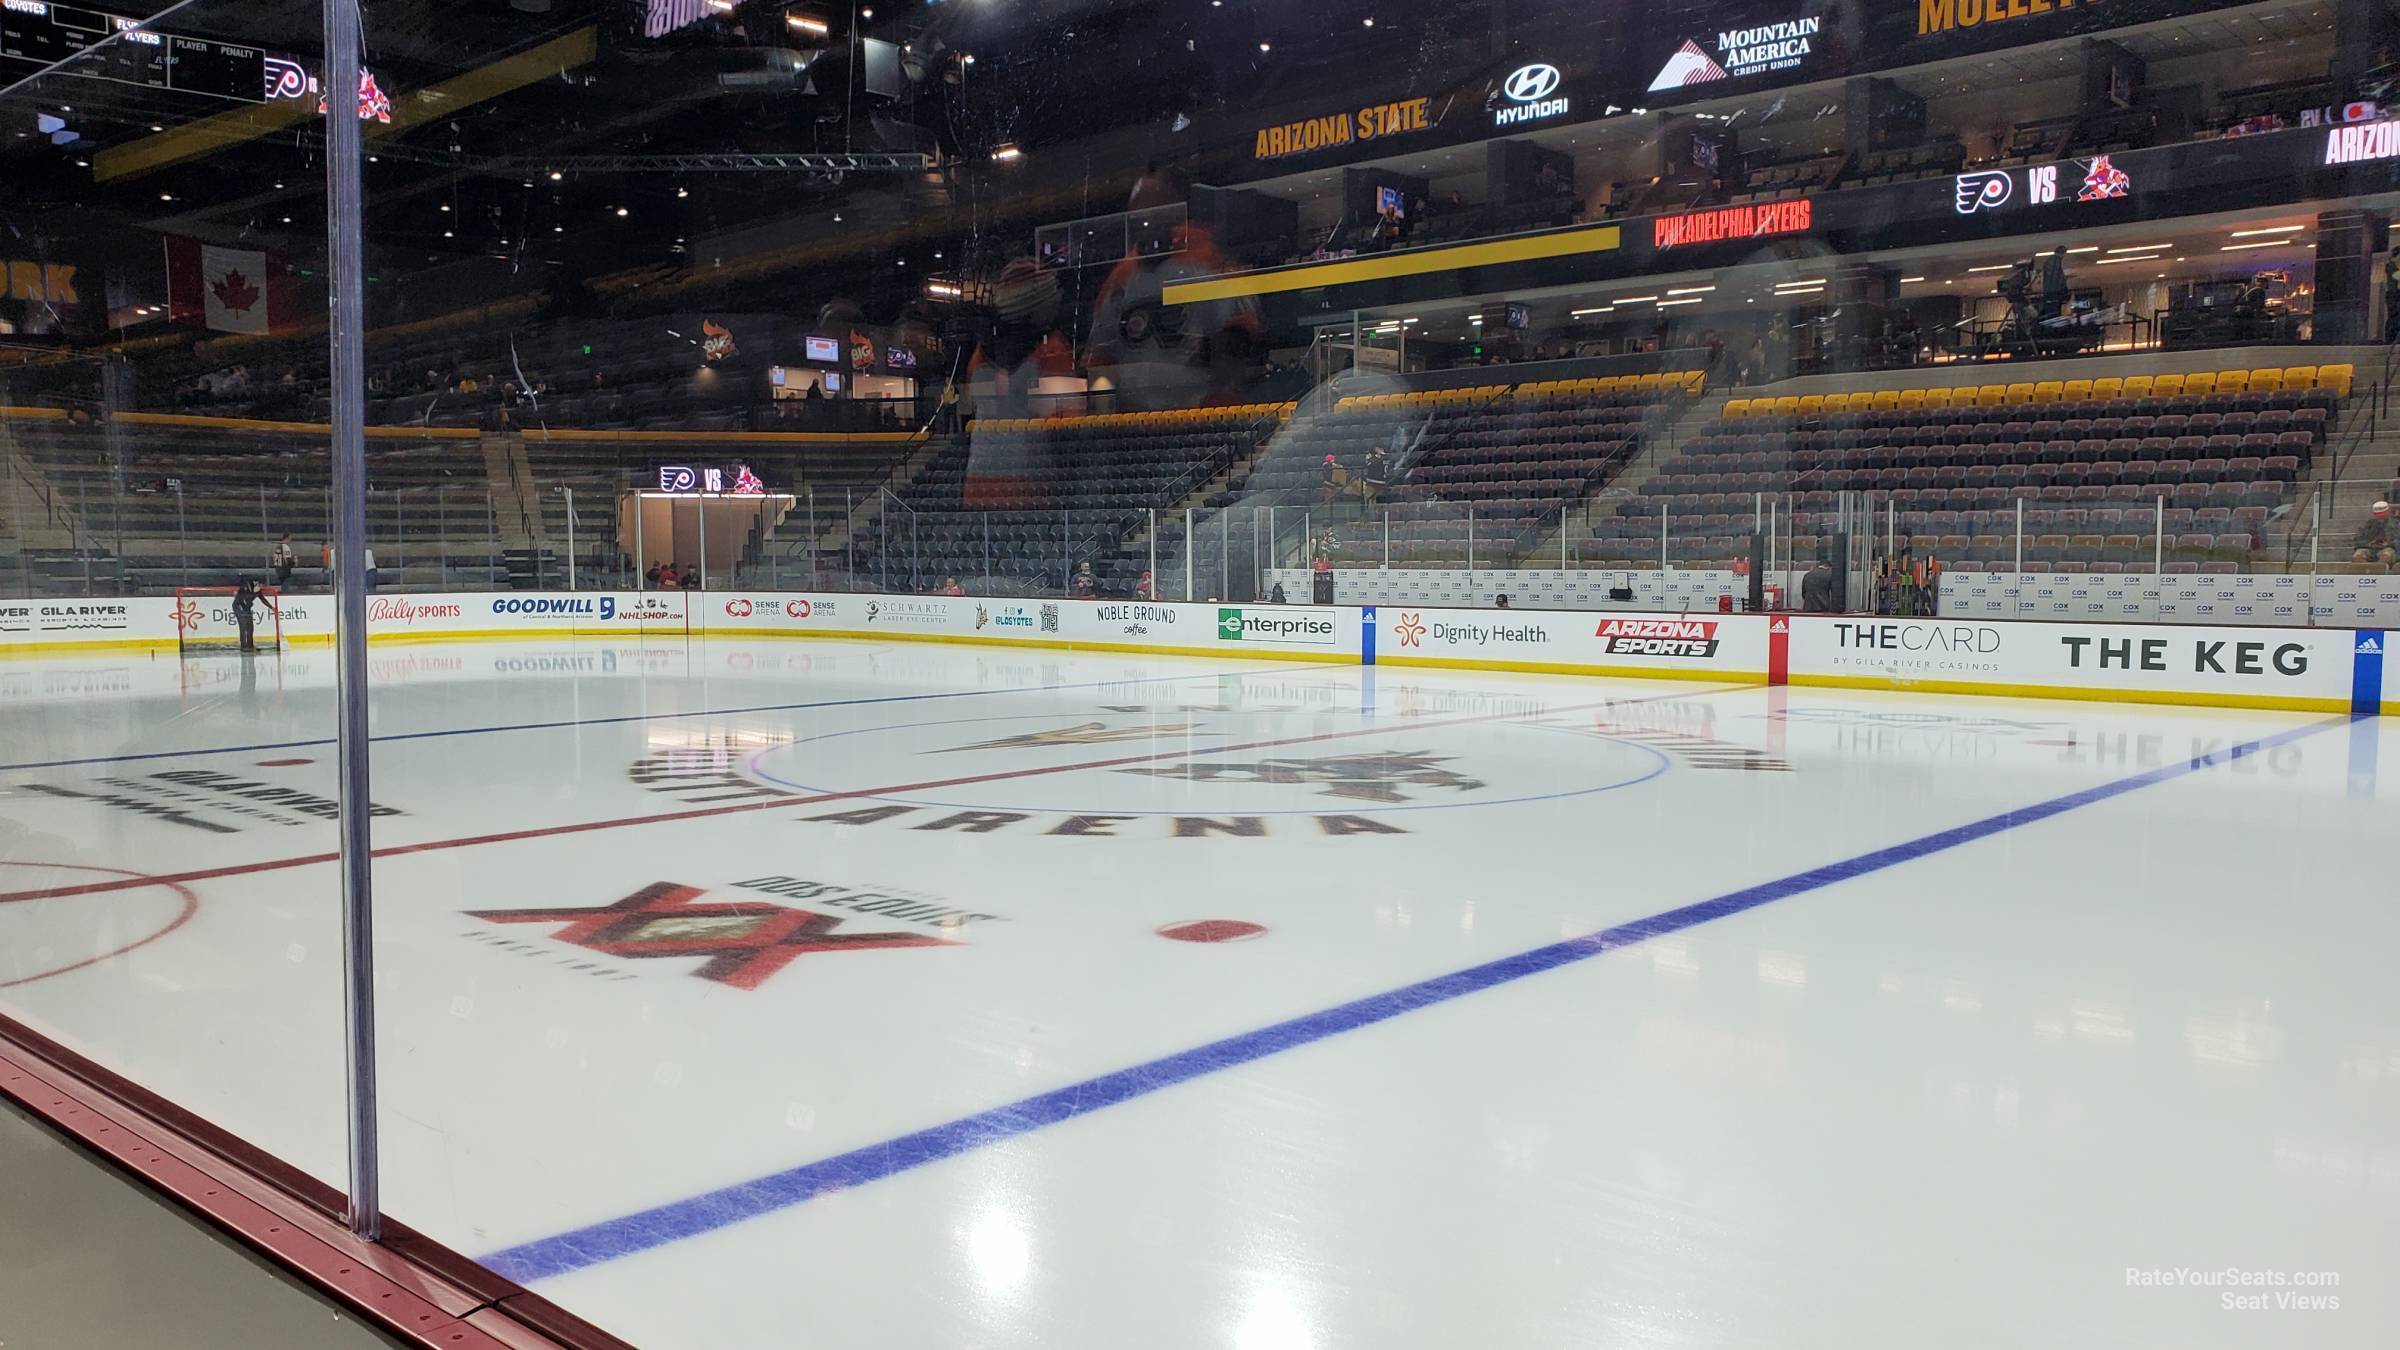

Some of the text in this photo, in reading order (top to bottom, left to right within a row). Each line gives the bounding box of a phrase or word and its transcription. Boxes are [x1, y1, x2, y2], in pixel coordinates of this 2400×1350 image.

[1918, 0, 2100, 35] MULL
[1718, 16, 1820, 51] MOUNTAIN
[177, 40, 254, 59] PLAYER PENALTY
[1725, 37, 1811, 68] AMERICA
[1734, 58, 1801, 76] CREDIT UNION
[1496, 98, 1568, 126] HYUNDAI
[1255, 97, 1430, 160] ARIZONA STATE
[2029, 166, 2056, 204] VS
[1655, 200, 1811, 248] PHILADELPHIA FLYERS
[704, 469, 721, 492] VS
[41, 606, 126, 616] GILA RIVER
[368, 598, 461, 625] Bally SPORTS
[492, 599, 593, 614] GOODWILL
[755, 601, 780, 609] SENSE
[756, 608, 781, 616] ARENA
[813, 601, 836, 609] SENSE
[813, 609, 836, 617] ARENA
[883, 602, 948, 614] SCHWARTZ
[213, 608, 265, 625] Digty
[995, 615, 1033, 626] @LOSYOTES
[1097, 606, 1176, 624] NOBLE GROUND
[1124, 624, 1148, 636] coffee
[1222, 616, 1333, 637] enterprise
[1433, 623, 1547, 645] Dignity Health
[1602, 622, 1705, 639] ARIZONA
[1613, 638, 1709, 656] SPORTS
[2062, 637, 2307, 676] THE KEG
[1893, 660, 1931, 668] RIVER
[1939, 661, 1999, 671] CASINOS
[148, 770, 268, 792] GILA
[794, 804, 1412, 837] ARENA
[728, 876, 850, 899] DOS
[820, 893, 998, 928] EQUIS
